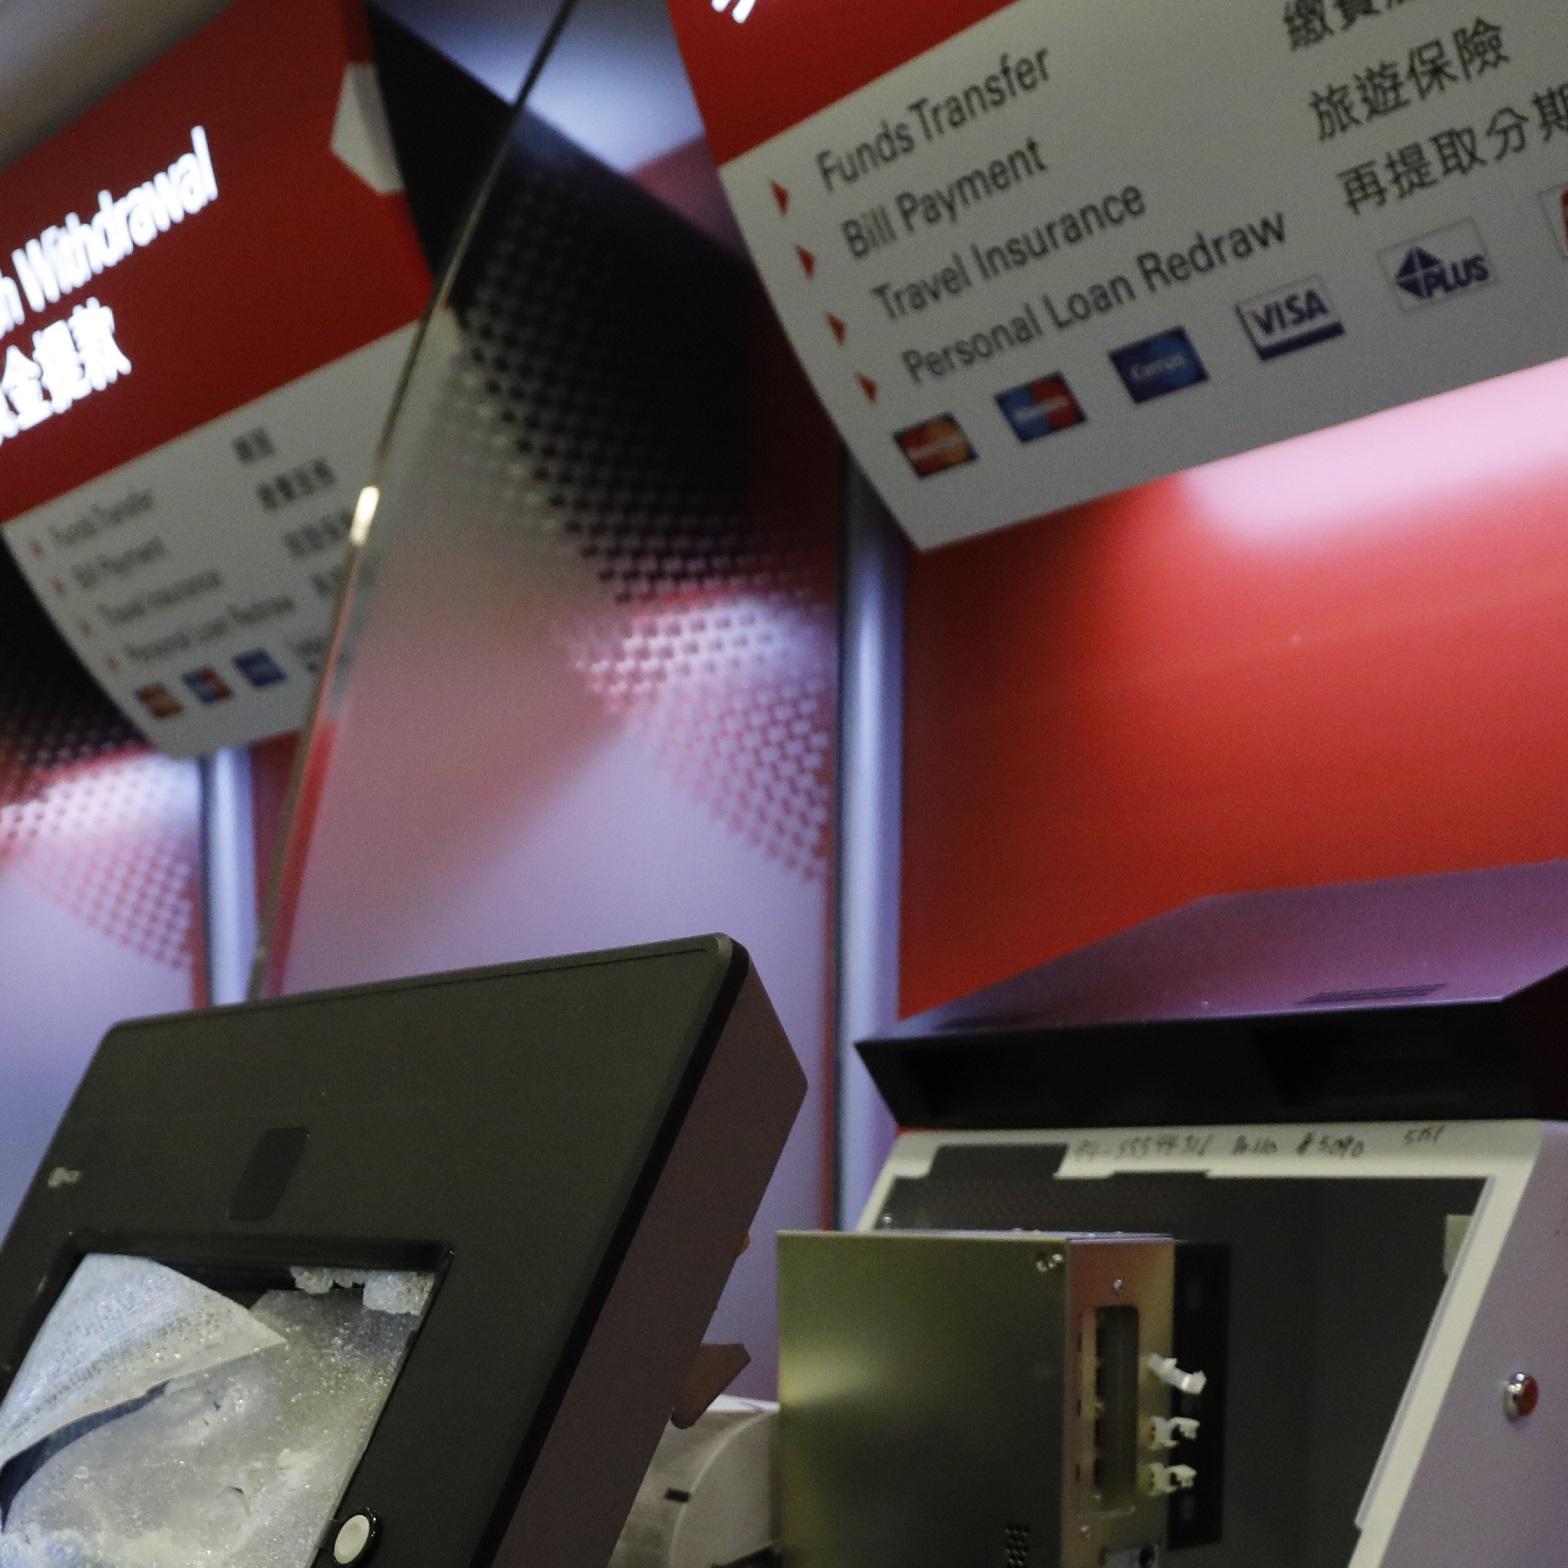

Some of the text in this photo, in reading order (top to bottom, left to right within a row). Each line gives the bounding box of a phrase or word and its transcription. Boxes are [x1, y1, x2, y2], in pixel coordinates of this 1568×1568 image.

[816, 46, 1050, 192] Funds Transfer
[1309, 16, 1511, 142] 旅遊保險
[12, 125, 218, 312] Withdrawal
[841, 136, 1047, 259] Bill Payment
[875, 185, 1147, 320] Travel Insurance
[902, 212, 1287, 384] Personal Loan Redraw
[1252, 288, 1330, 337] VISA
[1426, 254, 1489, 297] PLUS
